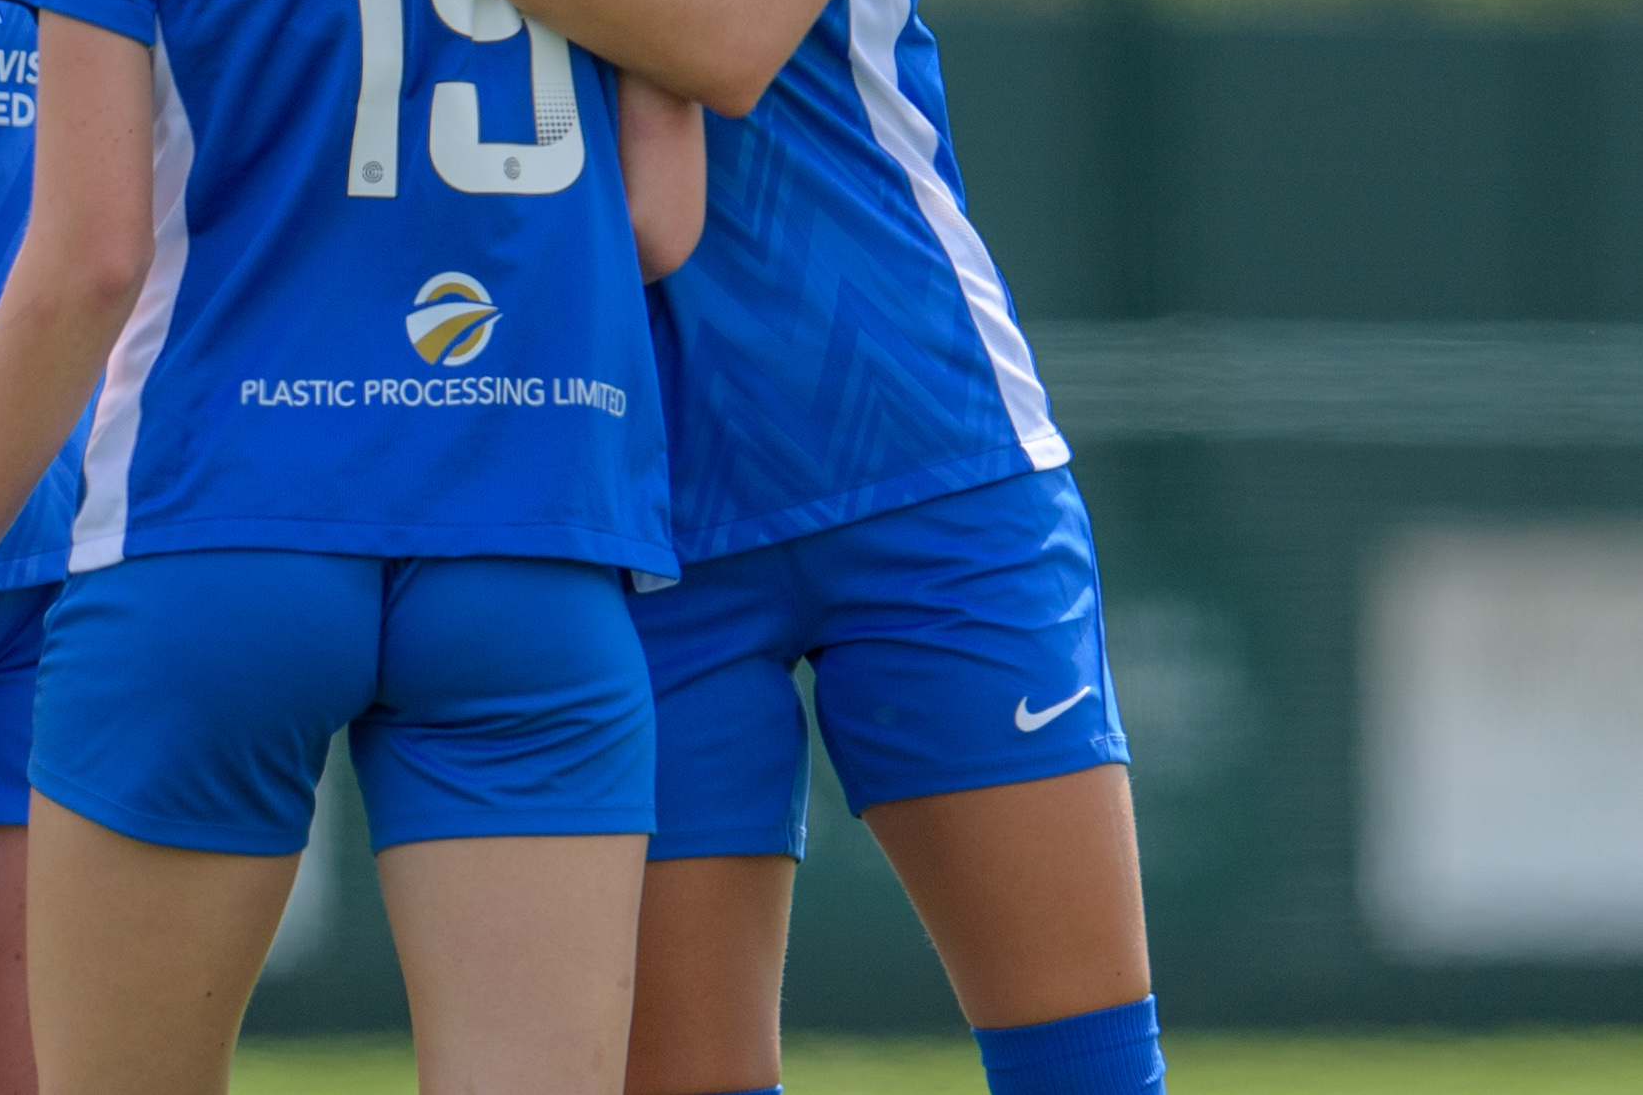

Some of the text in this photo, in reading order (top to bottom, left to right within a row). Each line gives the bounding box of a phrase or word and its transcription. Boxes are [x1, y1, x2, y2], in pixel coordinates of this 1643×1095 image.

[241, 376, 626, 418] PLASTIC PROCESSING LIMITED
